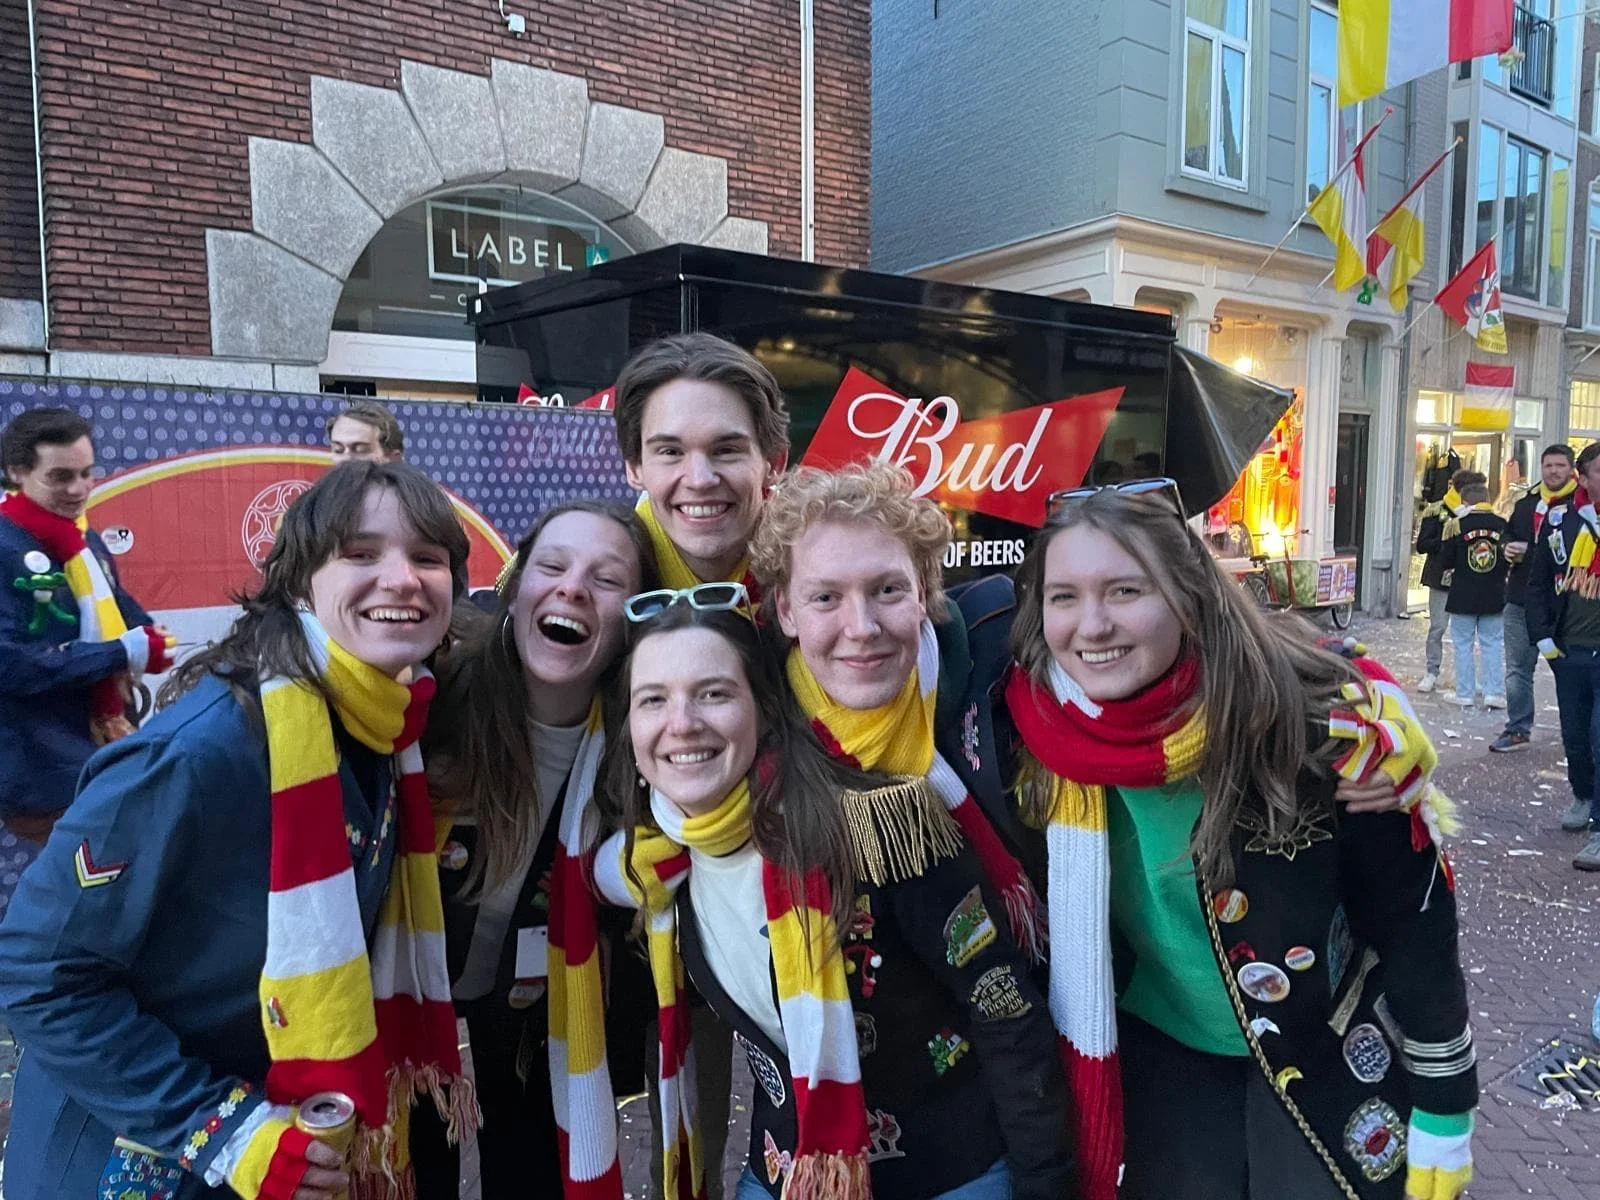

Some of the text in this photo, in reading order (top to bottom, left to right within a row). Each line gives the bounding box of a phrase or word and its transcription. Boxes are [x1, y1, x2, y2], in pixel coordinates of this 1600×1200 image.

[451, 228, 573, 272] LABEL
[847, 392, 1054, 499] Bud
[943, 539, 1025, 568] OF BEERS
